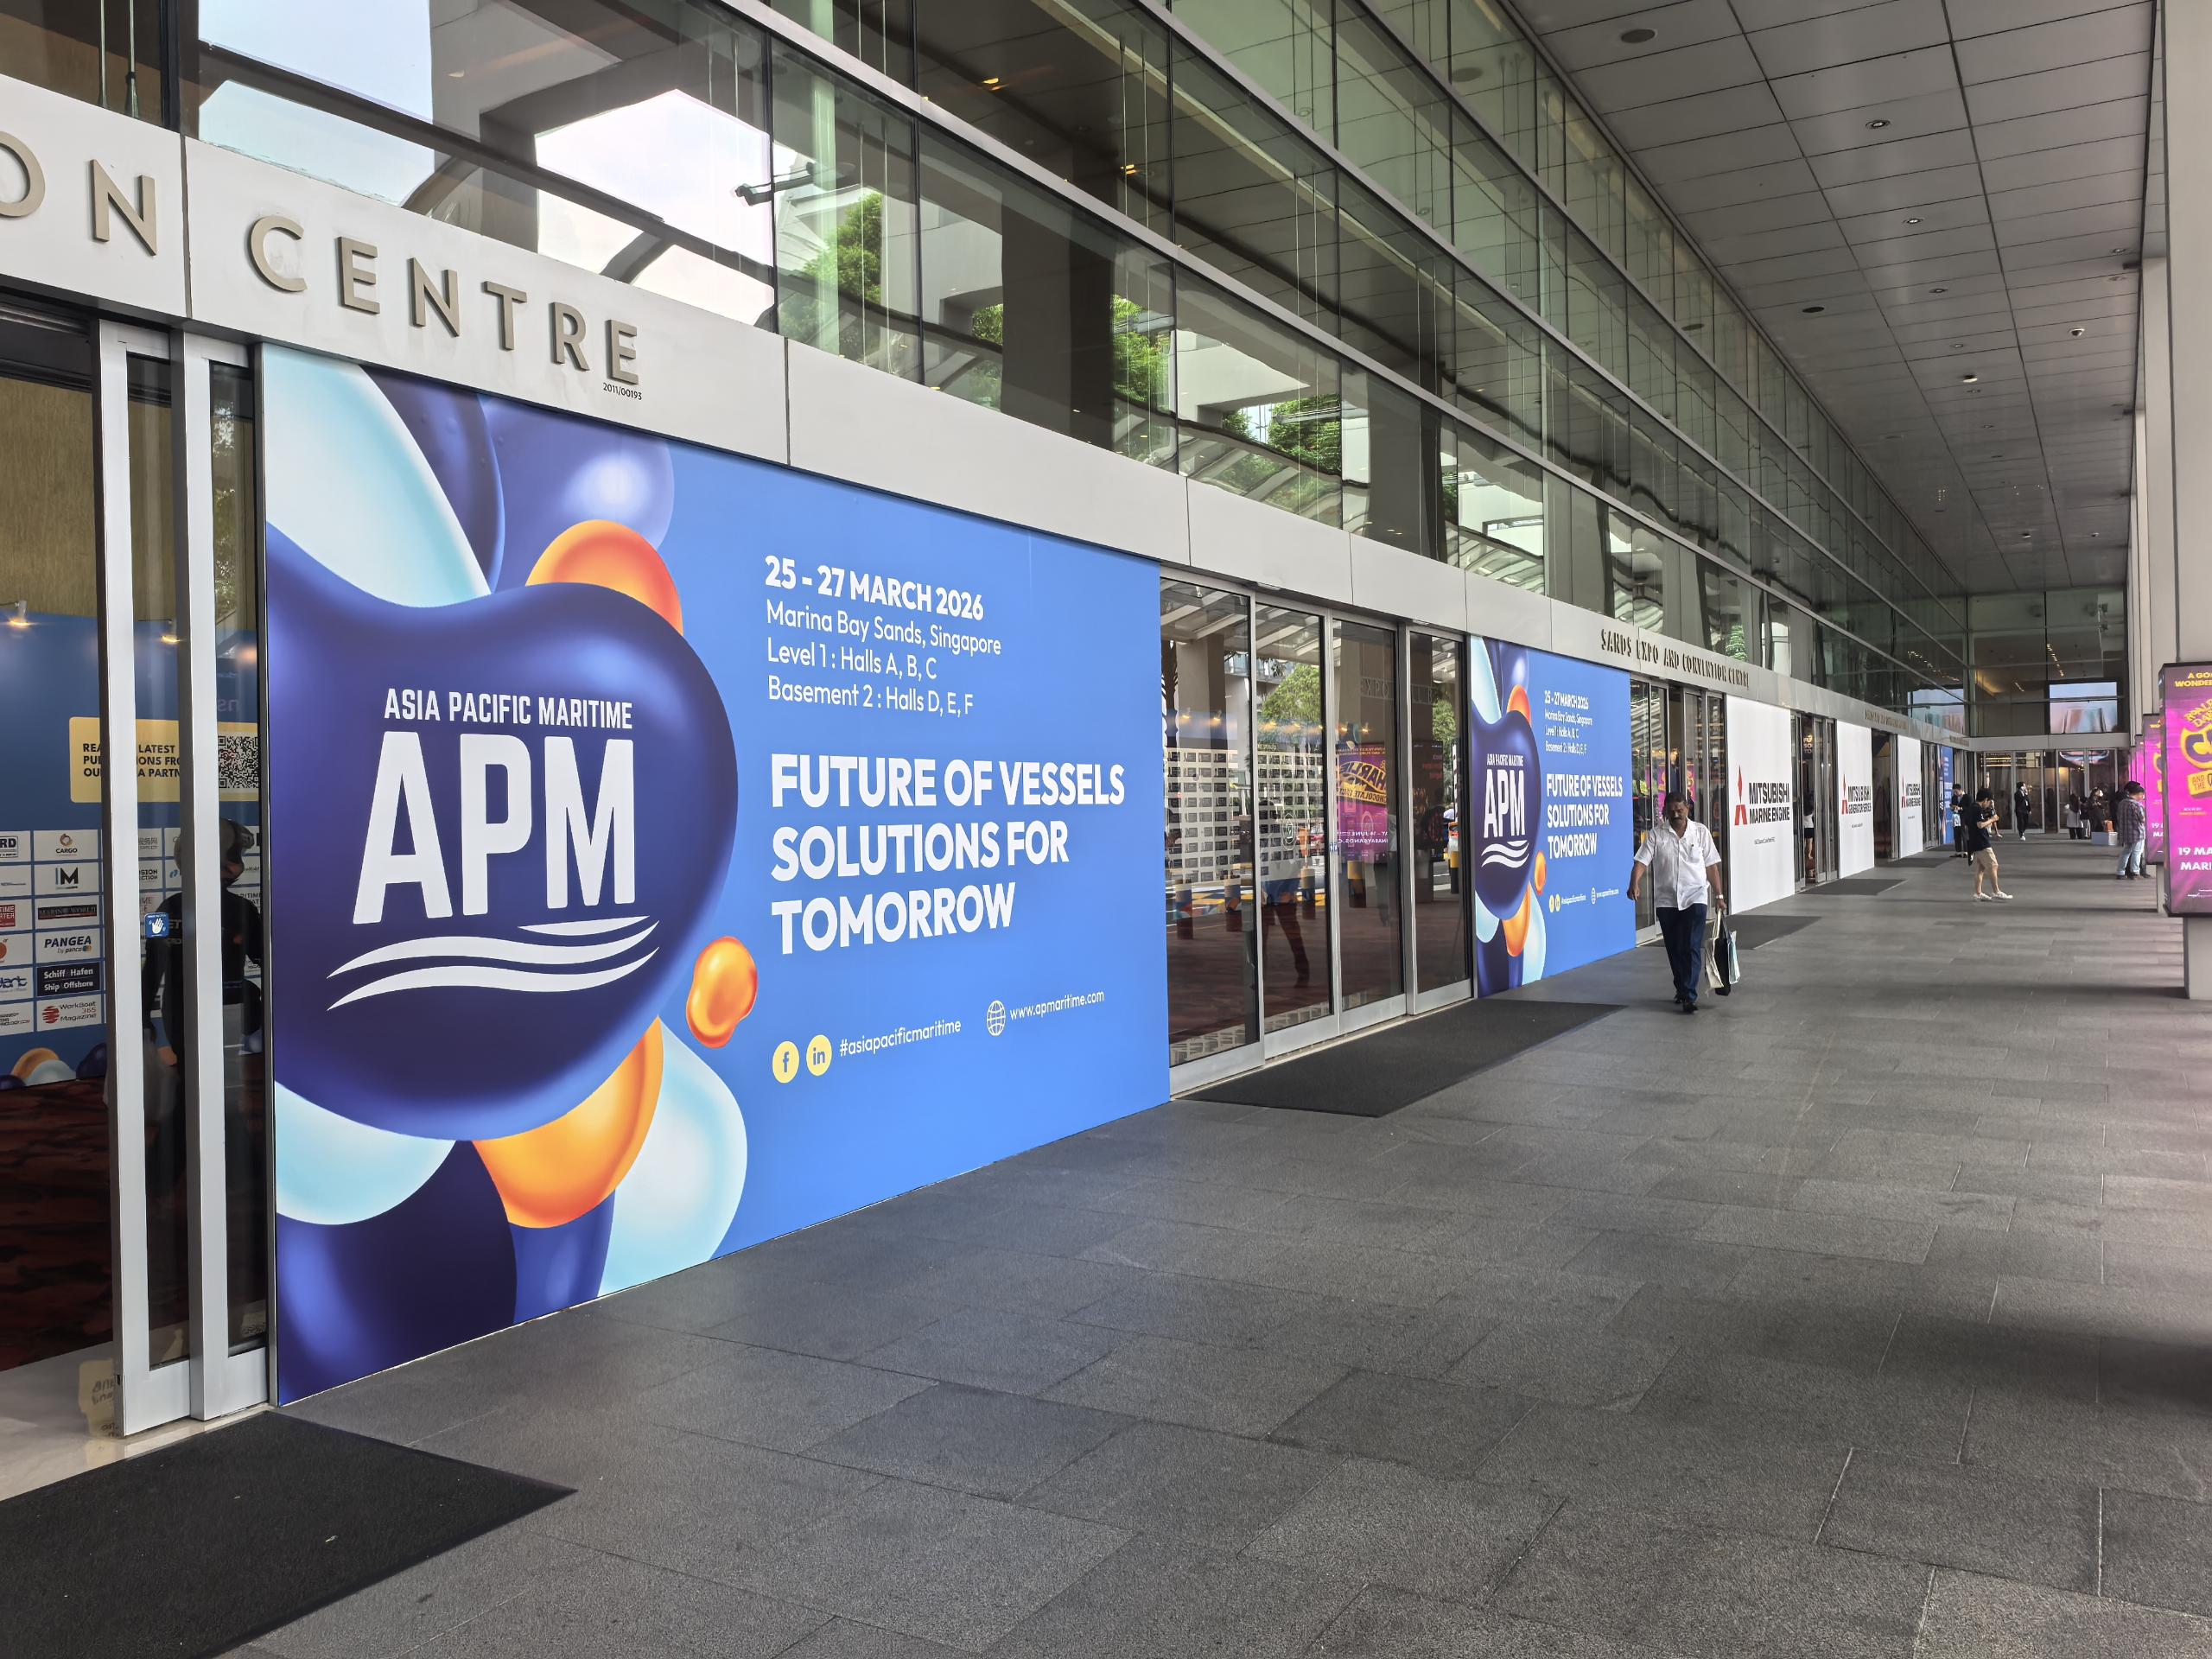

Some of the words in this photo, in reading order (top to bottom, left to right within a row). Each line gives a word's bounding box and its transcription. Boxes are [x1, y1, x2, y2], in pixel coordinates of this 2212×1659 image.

[248, 215, 639, 385] CENTRE
[603, 382, 642, 400] 2011/00193
[765, 555, 797, 589] 25
[817, 565, 844, 597] 27
[849, 570, 931, 612] MARCH
[936, 587, 984, 620] 2026
[766, 599, 832, 632] Marina
[837, 611, 869, 642] Bay
[874, 619, 926, 648] Sands,
[930, 625, 1001, 656] Singapore
[767, 638, 816, 667] Level
[841, 646, 881, 674] Halls
[886, 654, 903, 680] A,
[907, 654, 922, 682] B,
[925, 657, 938, 679] C
[1601, 629, 1631, 657] SANDS
[1637, 639, 1659, 664] EXPO
[1663, 647, 1680, 670] AND
[1682, 653, 1726, 682] CONVENTION
[1728, 666, 1750, 690] CENTRE
[385, 689, 441, 721] ASIA
[449, 691, 531, 724] PACIFIC
[538, 696, 632, 729] MARITIME
[768, 675, 859, 708] Basement
[863, 684, 874, 708] 2
[887, 687, 924, 711] Halls
[928, 690, 944, 717] D,
[948, 692, 962, 718] E,
[964, 693, 974, 715] F
[1544, 690, 1551, 704] 25
[1560, 692, 1578, 709] MARCH
[1545, 709, 1558, 721] Marina
[138, 744, 175, 753] LATEST
[771, 753, 937, 809] FUTURE
[944, 759, 993, 806] OF
[999, 760, 1125, 806] VESSELS
[1546, 773, 1580, 798] FUTURE
[1580, 773, 1592, 797] OF
[1592, 773, 1623, 797] VESSELS
[1749, 782, 1789, 804] MITSUBISHI
[1484, 768, 1525, 838] APM
[1547, 804, 1593, 828] SOLUTIONS
[1594, 804, 1610, 826] FOR
[1749, 808, 1771, 824] MARINE
[1771, 807, 1790, 822] ENGINE
[353, 730, 636, 925] APM
[771, 821, 1001, 882] SOLUTIONS
[1007, 820, 1070, 866] FOR
[1548, 832, 1598, 860] TOMORROW
[2177, 847, 2191, 855] 19
[771, 881, 1016, 955] TOMORROW
[44, 936, 92, 948] PANGEA
[44, 969, 66, 979] Schiff
[70, 968, 93, 976] Hafen
[44, 983, 60, 992] Ship
[63, 981, 93, 989] Offshore
[59, 1001, 96, 1010] WorkBoat
[839, 1019, 962, 1057] #asiapacificmaritime
[1009, 989, 1104, 1020] www.apmaritime.com
